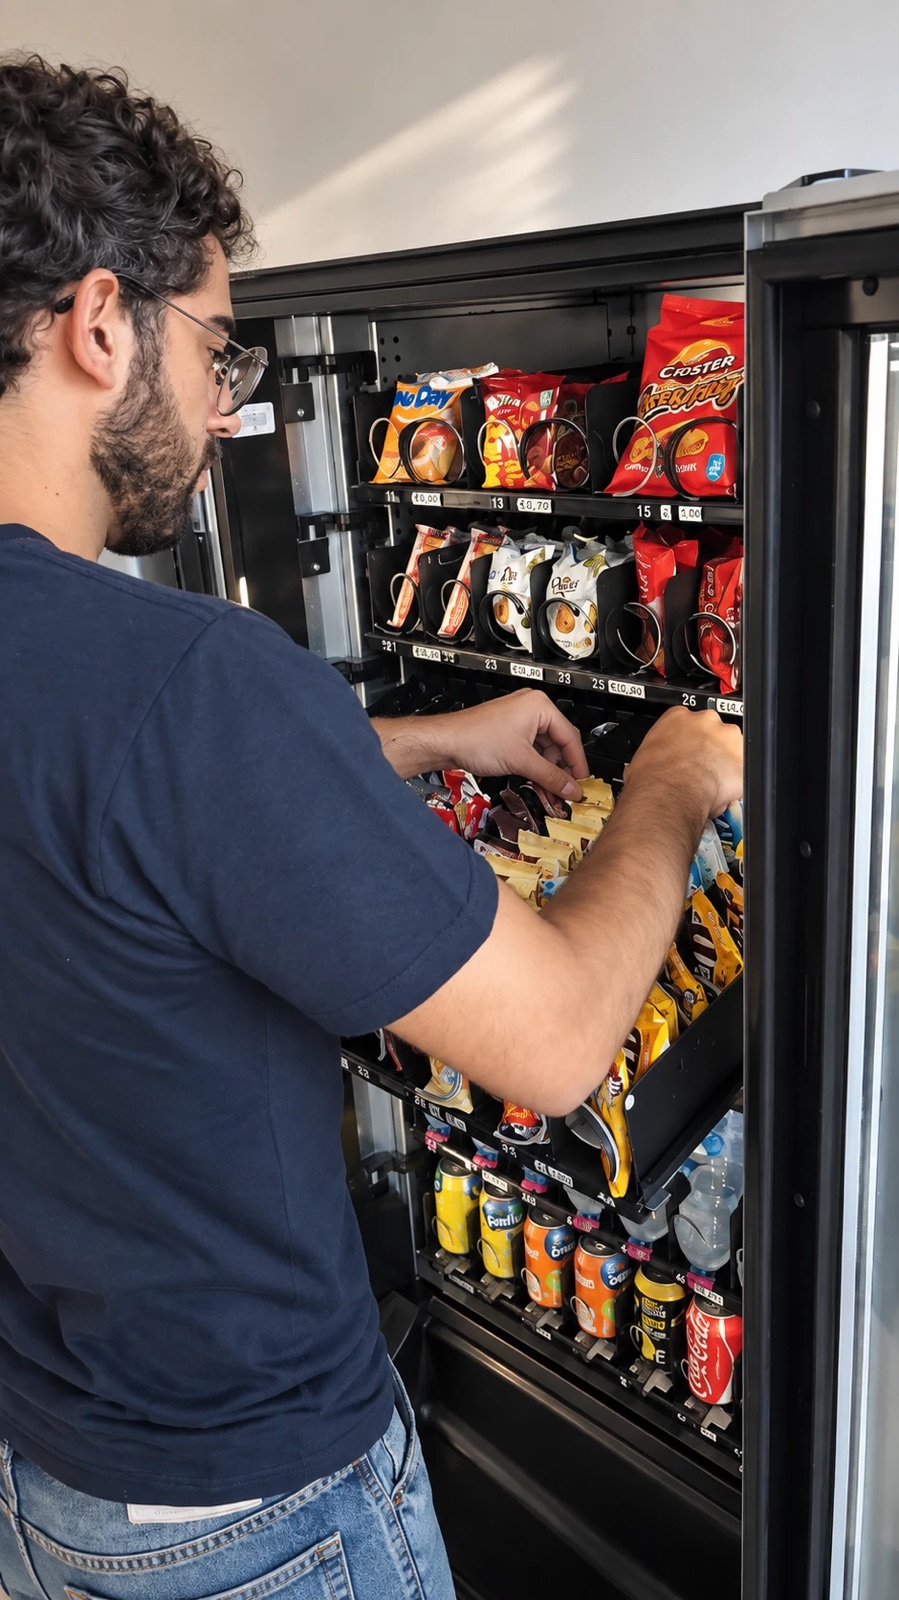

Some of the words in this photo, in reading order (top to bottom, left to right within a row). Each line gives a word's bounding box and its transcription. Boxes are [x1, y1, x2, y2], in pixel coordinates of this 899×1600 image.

[384, 490, 396, 503] 11
[491, 496, 504, 509] 13
[637, 504, 652, 518] 15
[681, 692, 697, 707] 26
